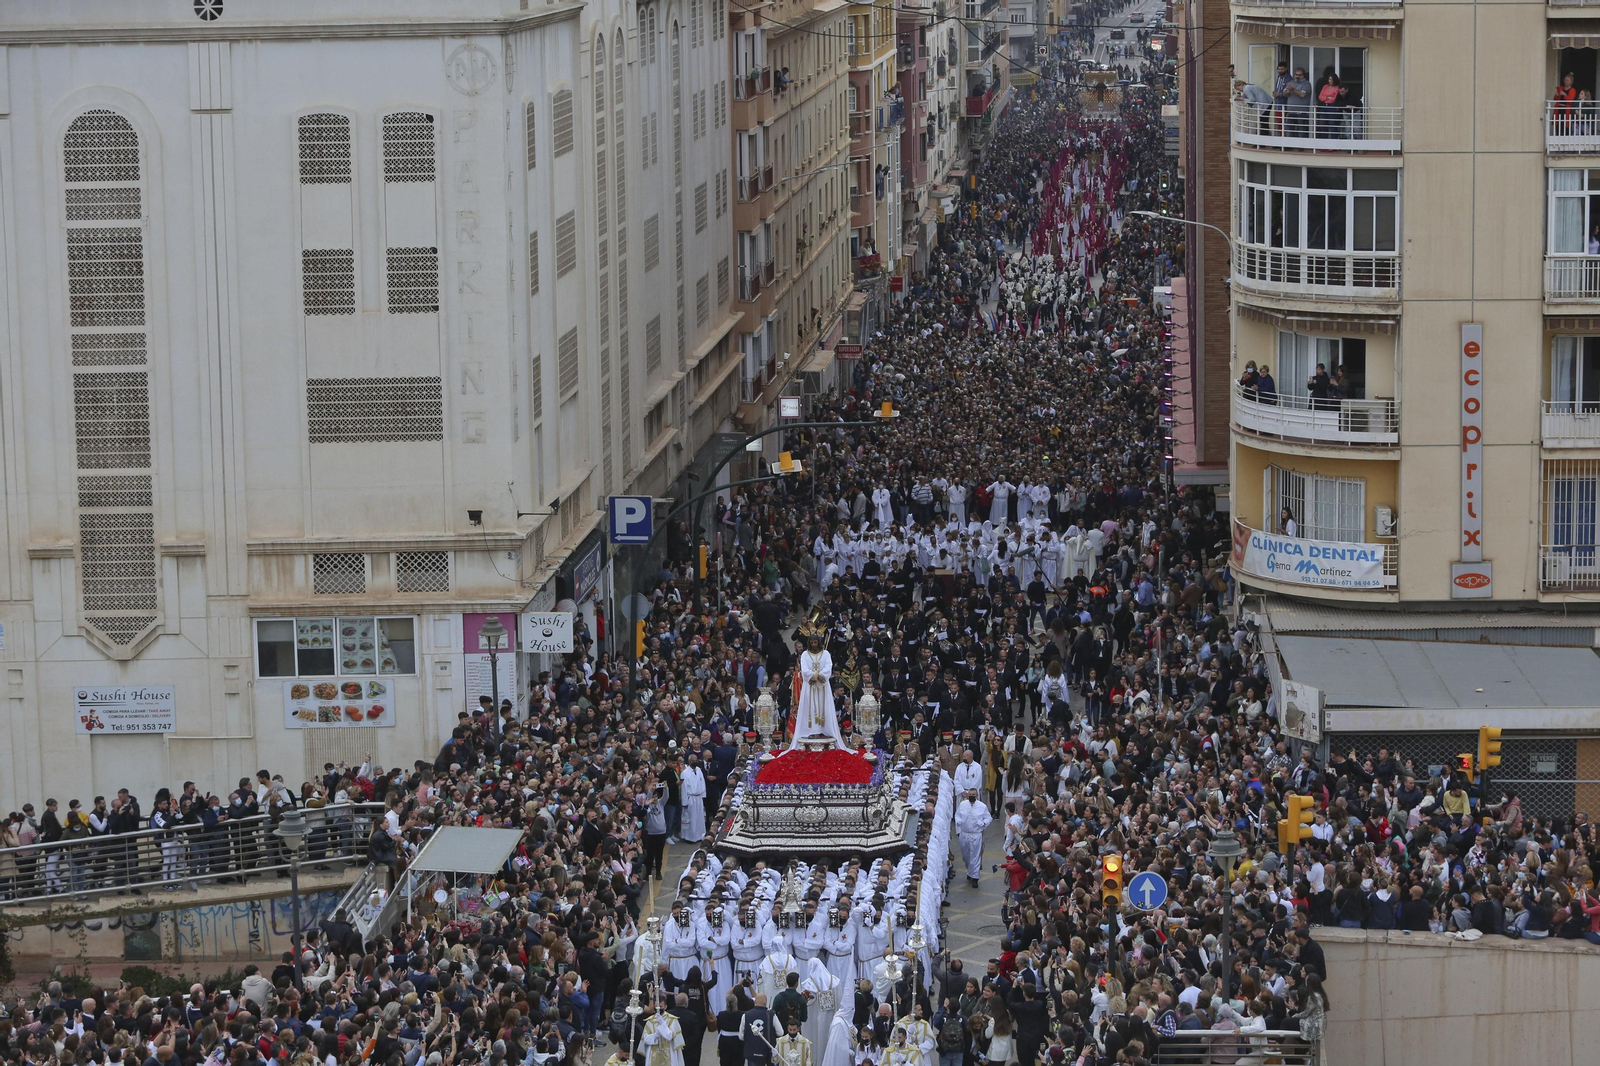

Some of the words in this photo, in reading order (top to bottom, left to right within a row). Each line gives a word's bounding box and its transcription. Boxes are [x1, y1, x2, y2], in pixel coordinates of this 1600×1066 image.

[1463, 341, 1482, 547] ecoprix
[614, 498, 647, 534] P
[1252, 536, 1303, 557] CLÍNICA
[1309, 545, 1380, 562] DENTAL
[1266, 553, 1291, 574] Gema
[1294, 559, 1352, 577] Martínez
[1455, 576, 1489, 587] ecoprix
[530, 614, 567, 629] Sushi
[530, 639, 567, 652] House
[91, 688, 127, 701] Sushi
[130, 688, 171, 701] House
